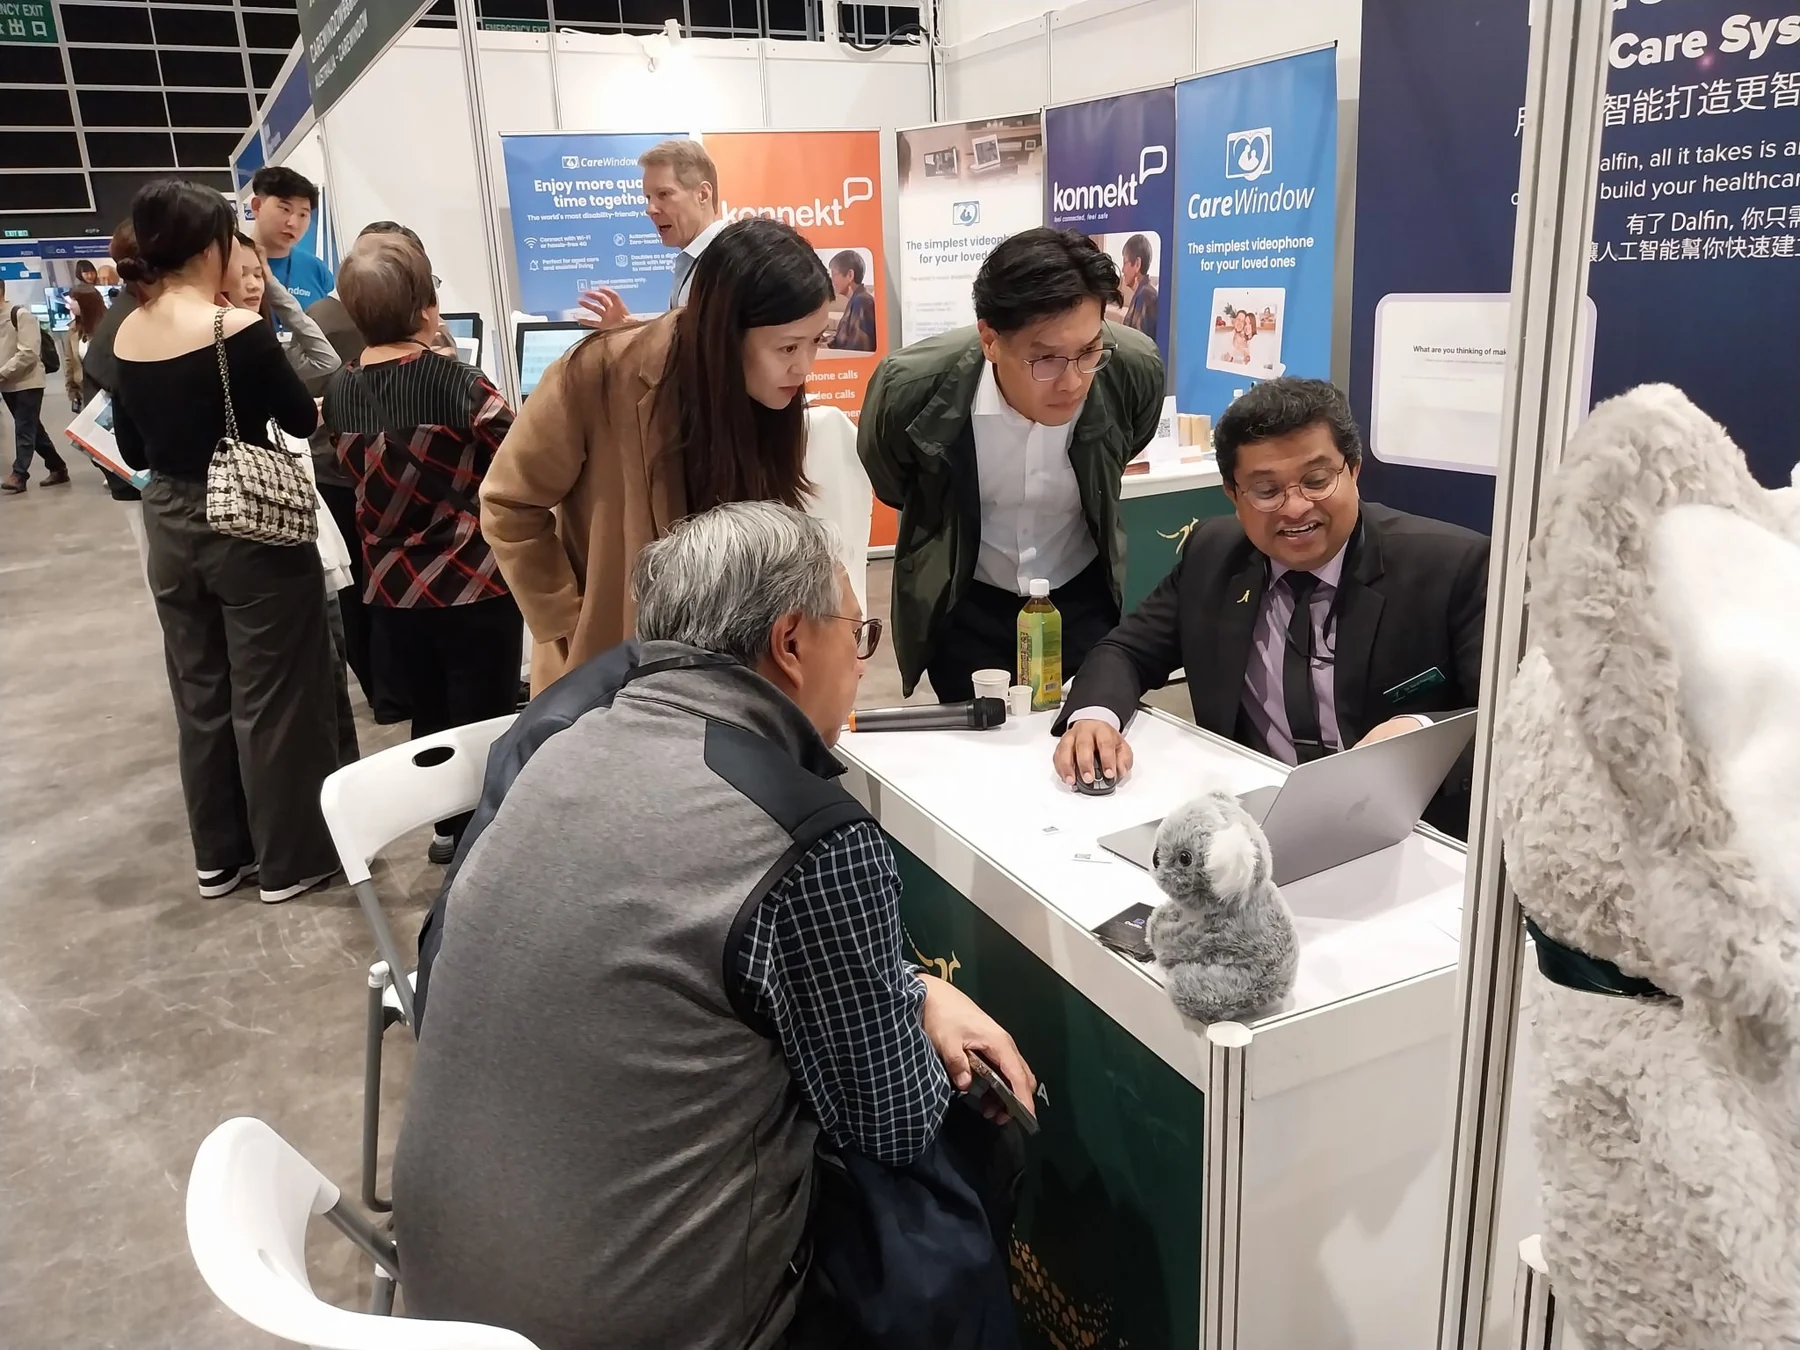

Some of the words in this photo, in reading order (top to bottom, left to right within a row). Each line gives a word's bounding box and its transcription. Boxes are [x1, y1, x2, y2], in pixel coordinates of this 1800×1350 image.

[0, 3, 20, 16] NCY
[22, 4, 44, 17] EXIT
[1608, 29, 1708, 70] Care
[1719, 14, 1800, 60] Sys
[581, 156, 639, 168] CareWindow
[1600, 152, 1644, 172] alfin,
[1650, 148, 1673, 168] all
[1677, 147, 1690, 165] it
[1696, 143, 1753, 164] takes
[1760, 140, 1777, 158] is
[534, 178, 573, 195] Enjoy
[575, 179, 614, 191] more
[616, 178, 644, 193] qua
[1053, 172, 1139, 213] konnekt
[1600, 179, 1647, 200] build
[1651, 177, 1697, 201] your
[553, 195, 587, 208] time
[1187, 182, 1316, 219] CareWindow
[541, 212, 564, 221] world's
[582, 210, 640, 220] disability-friendly
[1626, 212, 1666, 235] 有了
[1671, 208, 1734, 232] Dalfin,
[906, 240, 922, 250] The
[924, 237, 968, 251] simplest
[1187, 242, 1205, 255] The
[1205, 239, 1250, 256] simplest
[1251, 235, 1315, 253] videophone
[919, 253, 933, 264] for
[935, 254, 959, 266] your
[960, 250, 988, 262] loved
[1200, 258, 1215, 271] for
[1216, 259, 1240, 274] your
[1241, 256, 1269, 270] loved
[1269, 256, 1296, 268] ones
[1413, 345, 1431, 353] What
[1442, 347, 1455, 357] you
[1456, 347, 1483, 357] thinking
[1484, 347, 1492, 355] of
[837, 368, 859, 380] calls
[835, 389, 856, 399] calls
